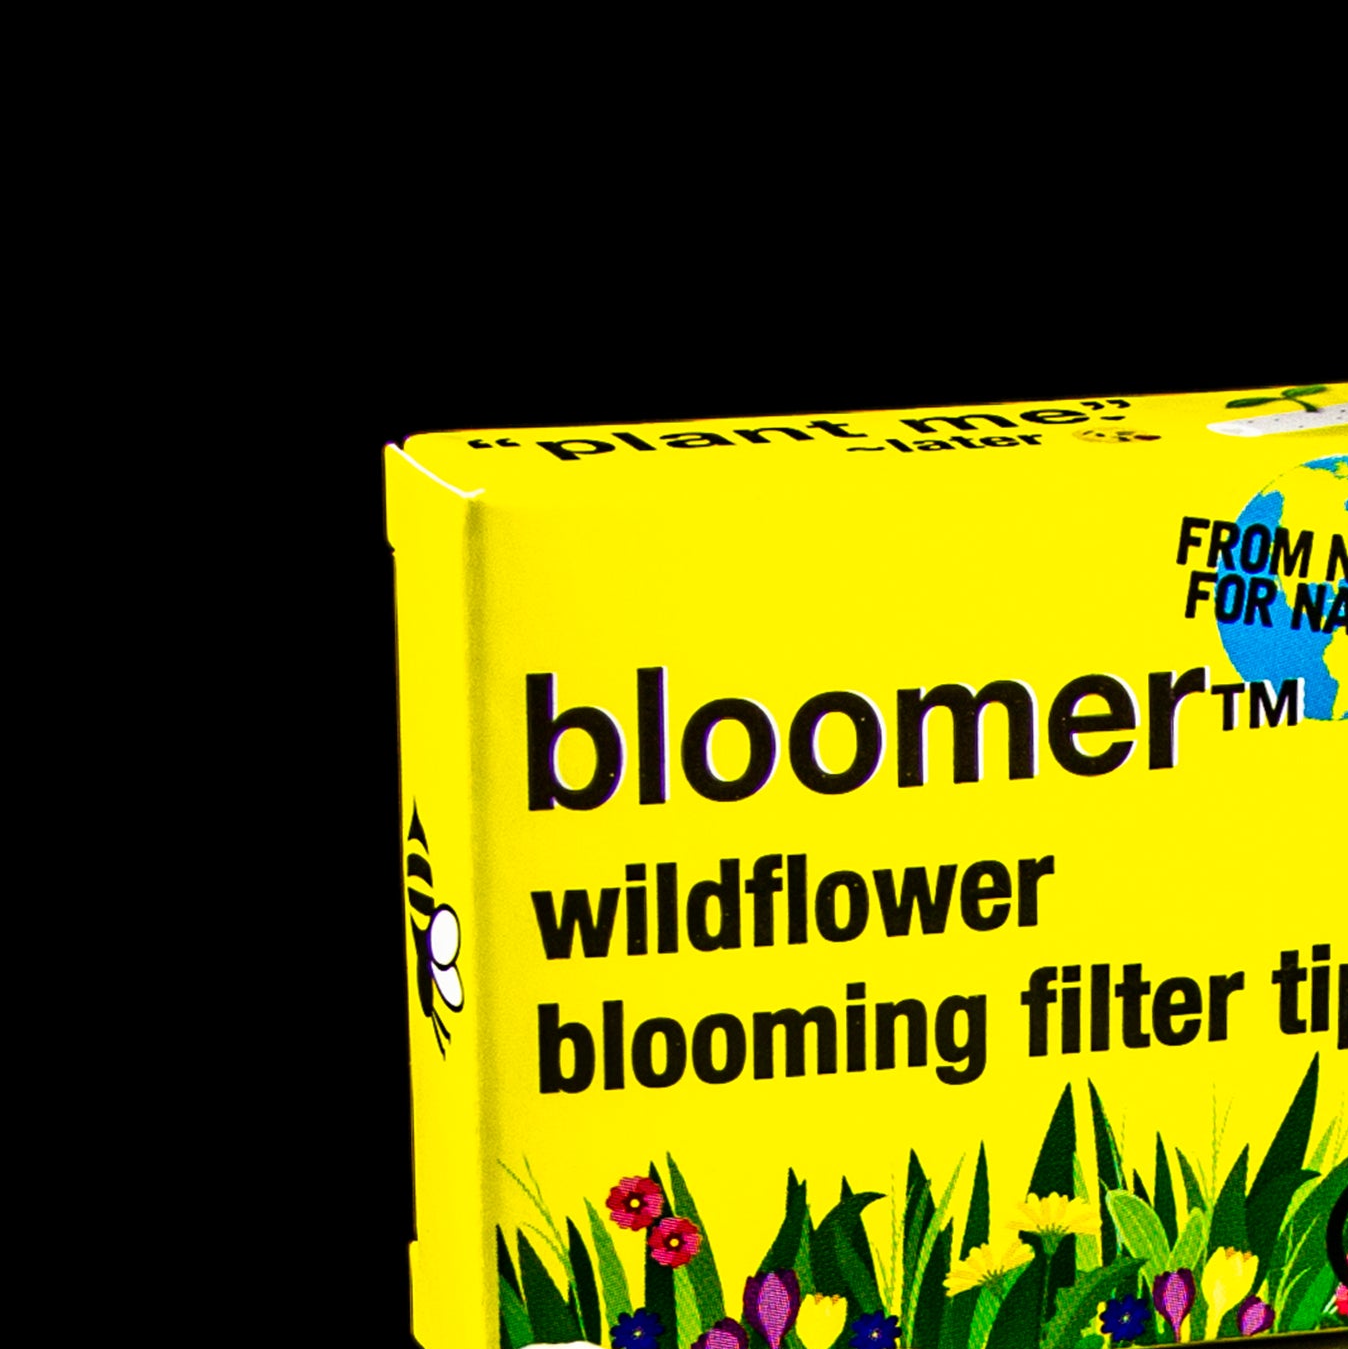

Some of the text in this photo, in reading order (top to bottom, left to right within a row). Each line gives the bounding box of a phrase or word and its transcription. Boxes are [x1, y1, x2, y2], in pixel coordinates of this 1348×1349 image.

[1175, 515, 1314, 579] FROM
[1184, 570, 1278, 629] FOR
[530, 853, 1055, 960] wildflower
[537, 981, 988, 1093] blooming
[1020, 963, 1246, 1057] filter
